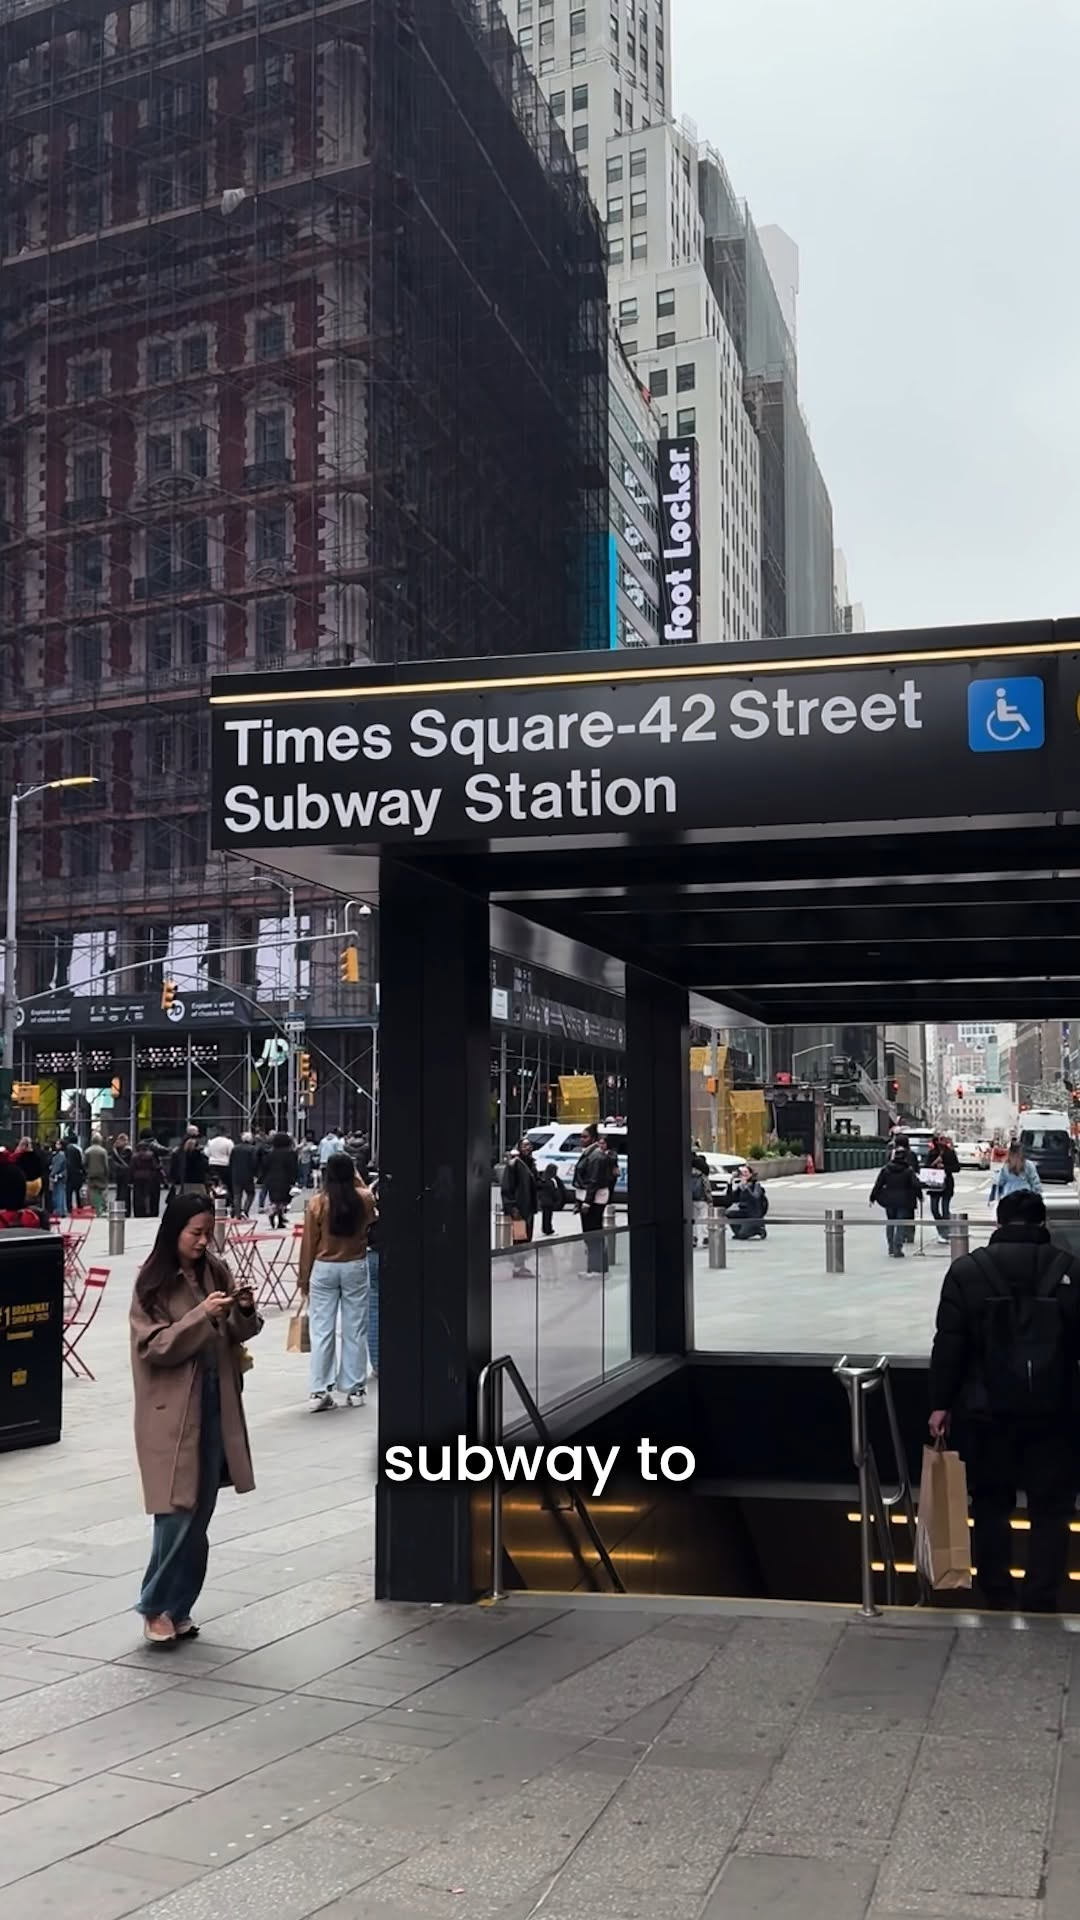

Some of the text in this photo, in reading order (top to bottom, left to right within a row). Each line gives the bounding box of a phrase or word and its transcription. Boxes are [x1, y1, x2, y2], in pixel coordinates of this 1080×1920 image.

[224, 680, 923, 766] Times Square-42 Street
[224, 769, 677, 836] Subway Station
[255, 1038, 289, 1068] JD
